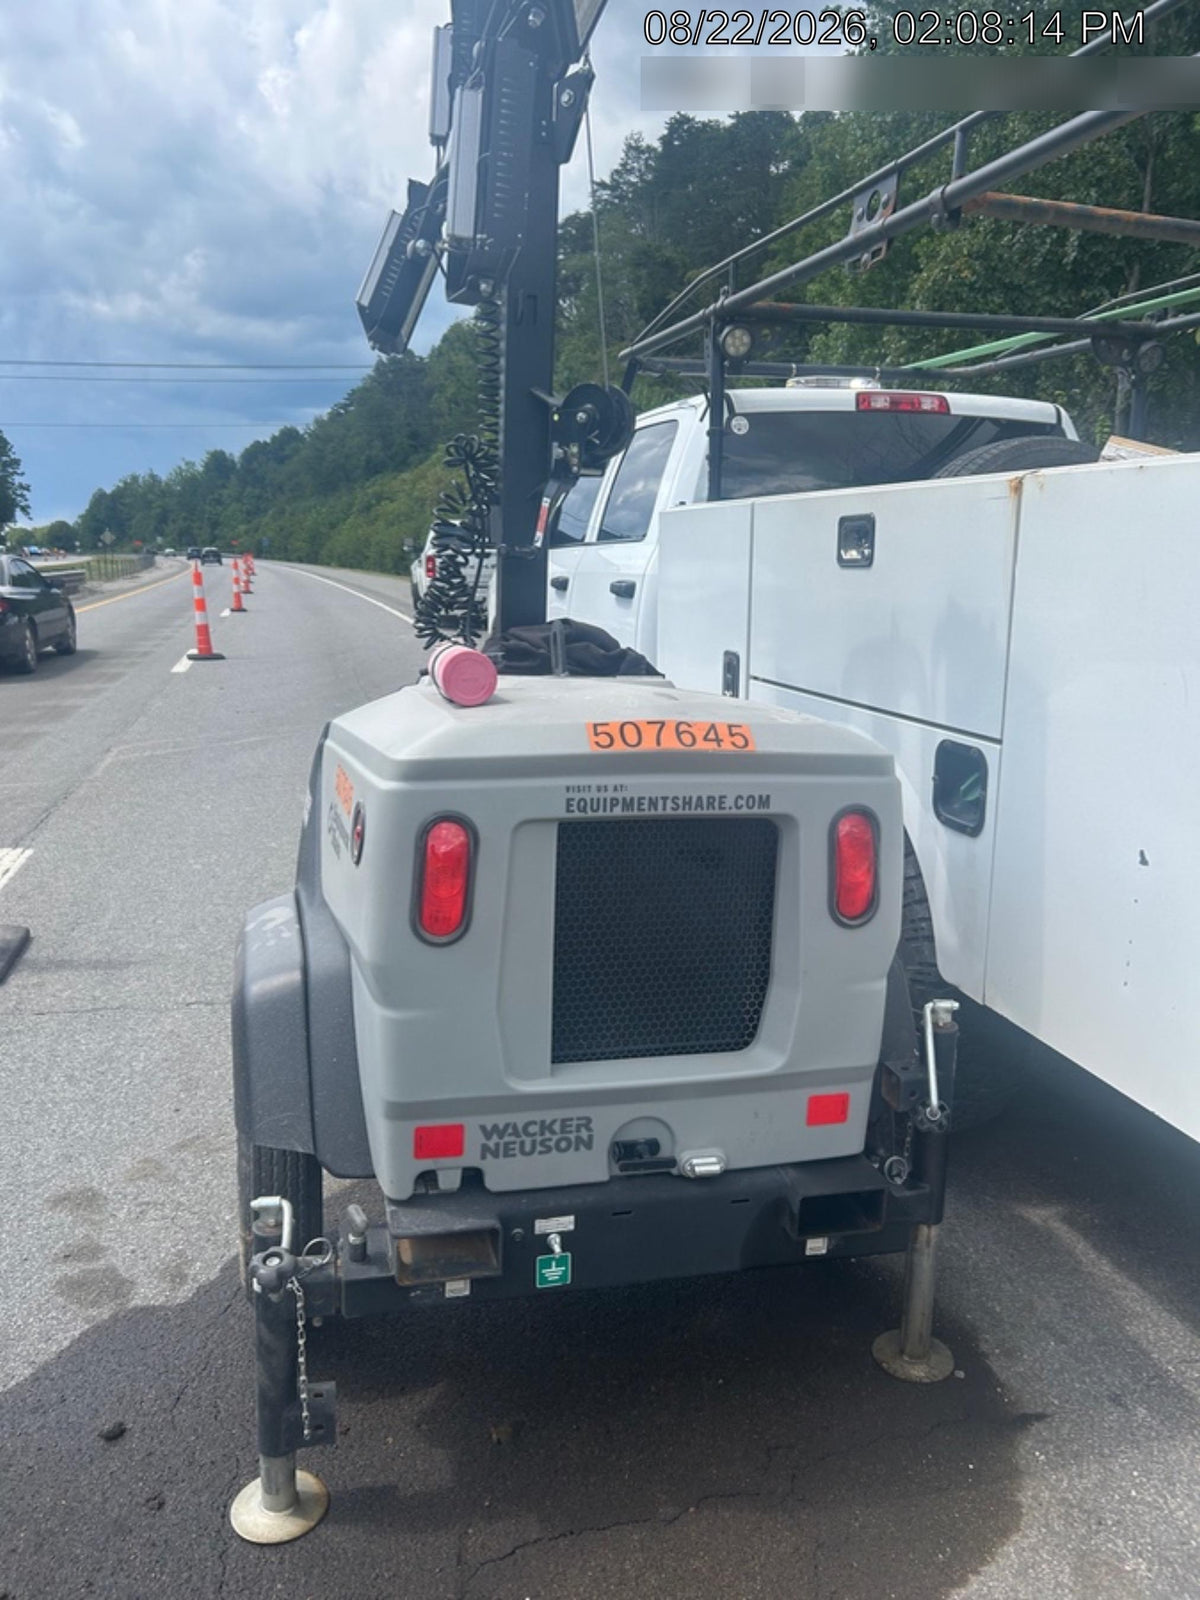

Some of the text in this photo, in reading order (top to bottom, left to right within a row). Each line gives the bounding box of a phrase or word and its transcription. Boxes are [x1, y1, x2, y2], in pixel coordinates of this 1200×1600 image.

[592, 720, 750, 750] 507645
[565, 784, 628, 794] VISIT US AT:
[565, 794, 772, 814] EQUIPMENTSHARE.COM
[479, 1116, 594, 1142] WACKER
[480, 1134, 594, 1161] NEUSON
